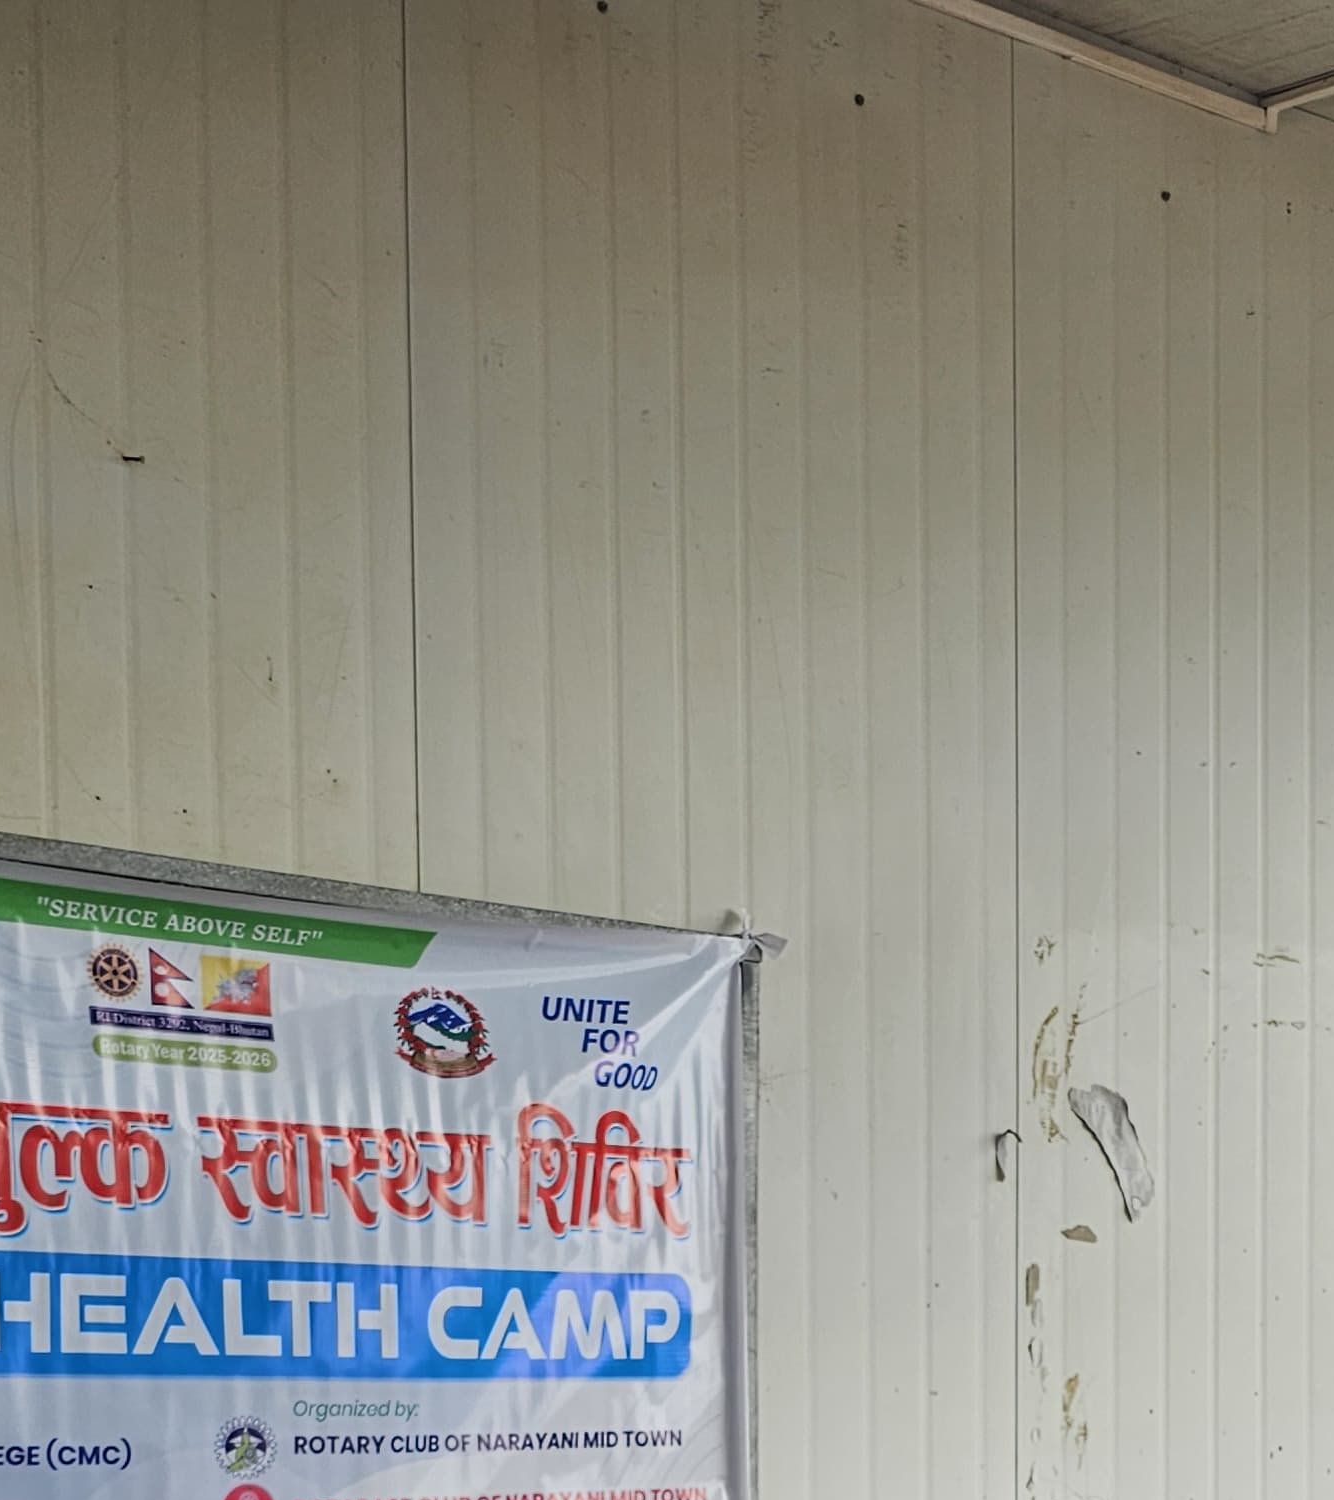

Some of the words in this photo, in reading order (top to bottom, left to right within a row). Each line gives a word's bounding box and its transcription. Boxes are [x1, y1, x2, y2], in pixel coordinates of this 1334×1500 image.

[36, 895, 159, 929] "SERVICE
[163, 912, 246, 939] ABOVE
[250, 923, 324, 947] SELF"
[113, 1012, 156, 1027] District
[541, 996, 631, 1024] UNITE
[99, 1037, 149, 1060] Rotary
[153, 1043, 186, 1060] Year
[188, 1046, 272, 1067] 2025-2026
[581, 1028, 640, 1057] FOR
[594, 1060, 658, 1091] GOOD
[197, 1115, 491, 1229] स्वास्थ्य
[517, 1102, 691, 1238] शिविर
[426, 1286, 682, 1361] CAMP
[293, 1399, 391, 1423] Organized
[394, 1399, 419, 1422] by:
[46, 1437, 132, 1470] (CMC)
[294, 1434, 385, 1454] ROTARY
[390, 1434, 440, 1453] CLUB
[445, 1433, 471, 1451] OF
[477, 1432, 579, 1451] NARAYANI
[583, 1430, 618, 1448] MID
[622, 1429, 682, 1448] TOWN
